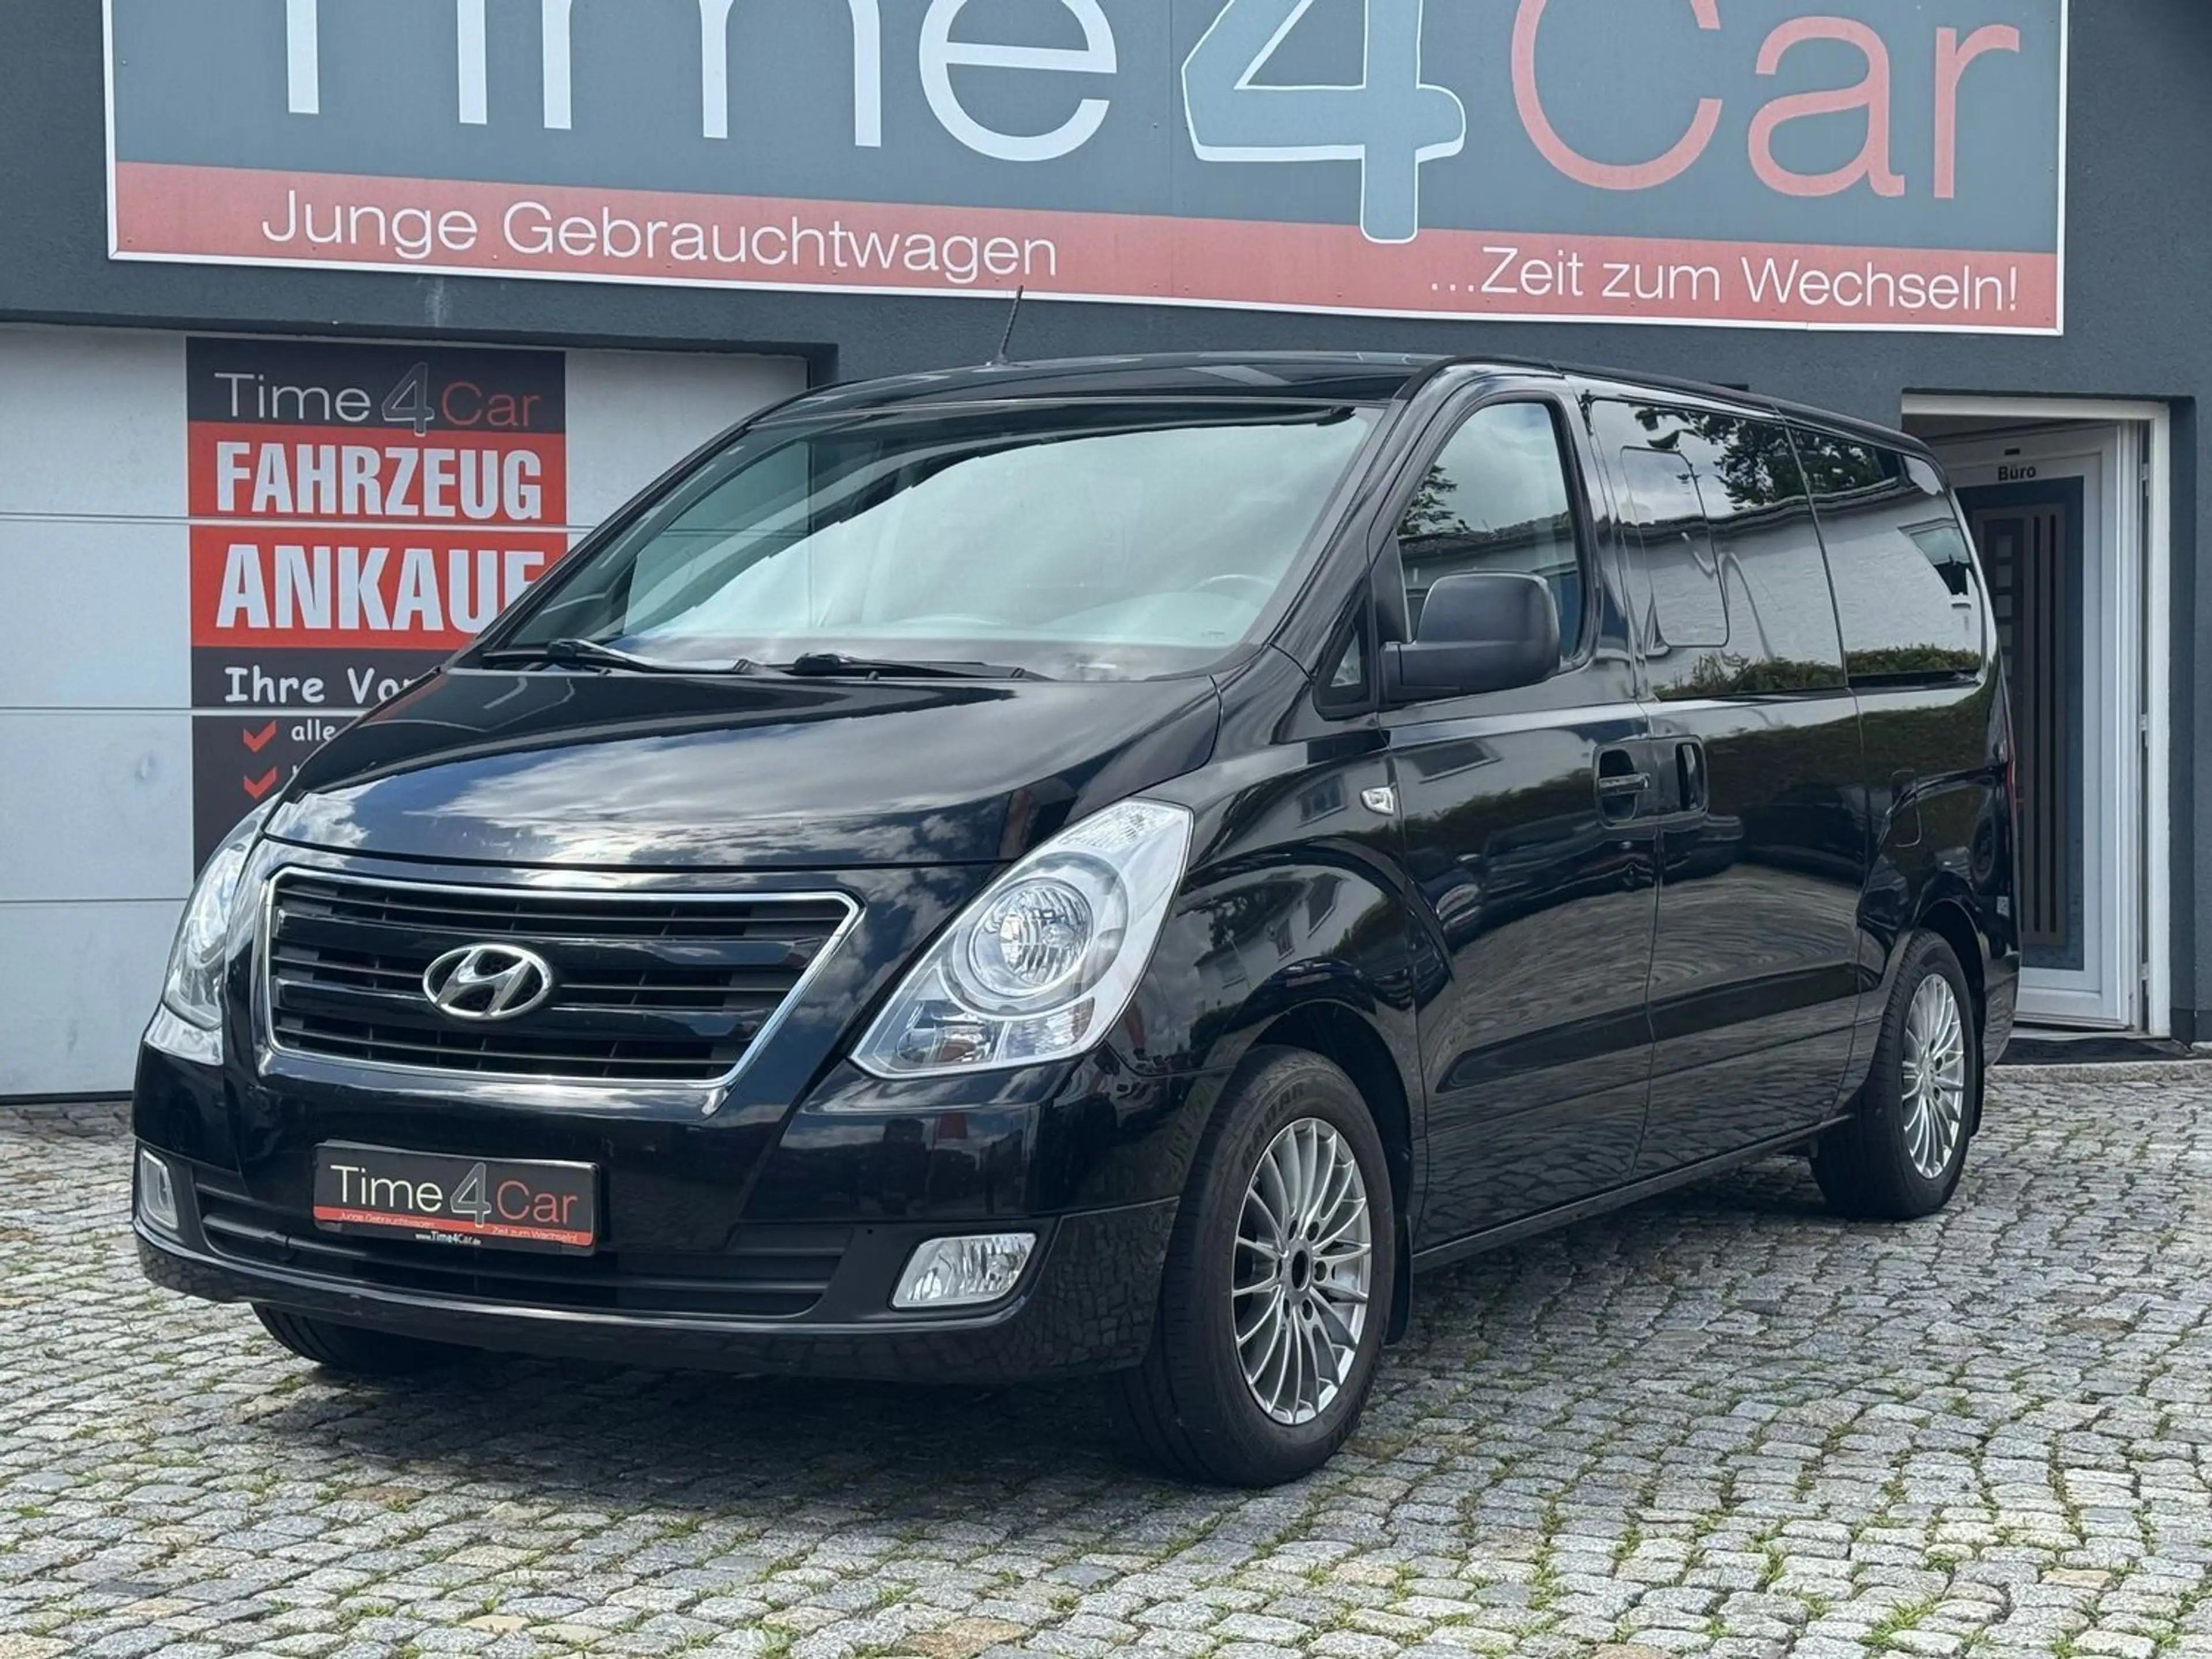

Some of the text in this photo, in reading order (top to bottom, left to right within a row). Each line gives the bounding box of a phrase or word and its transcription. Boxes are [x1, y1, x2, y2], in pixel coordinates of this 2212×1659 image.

[262, 190, 1057, 283] Junge Gebrauchtwagen
[1431, 246, 2018, 311] ...Zeit zum Wechseln!
[216, 442, 541, 519] FAHRZEUG
[224, 665, 325, 703] Ihre
[291, 719, 336, 741] alle
